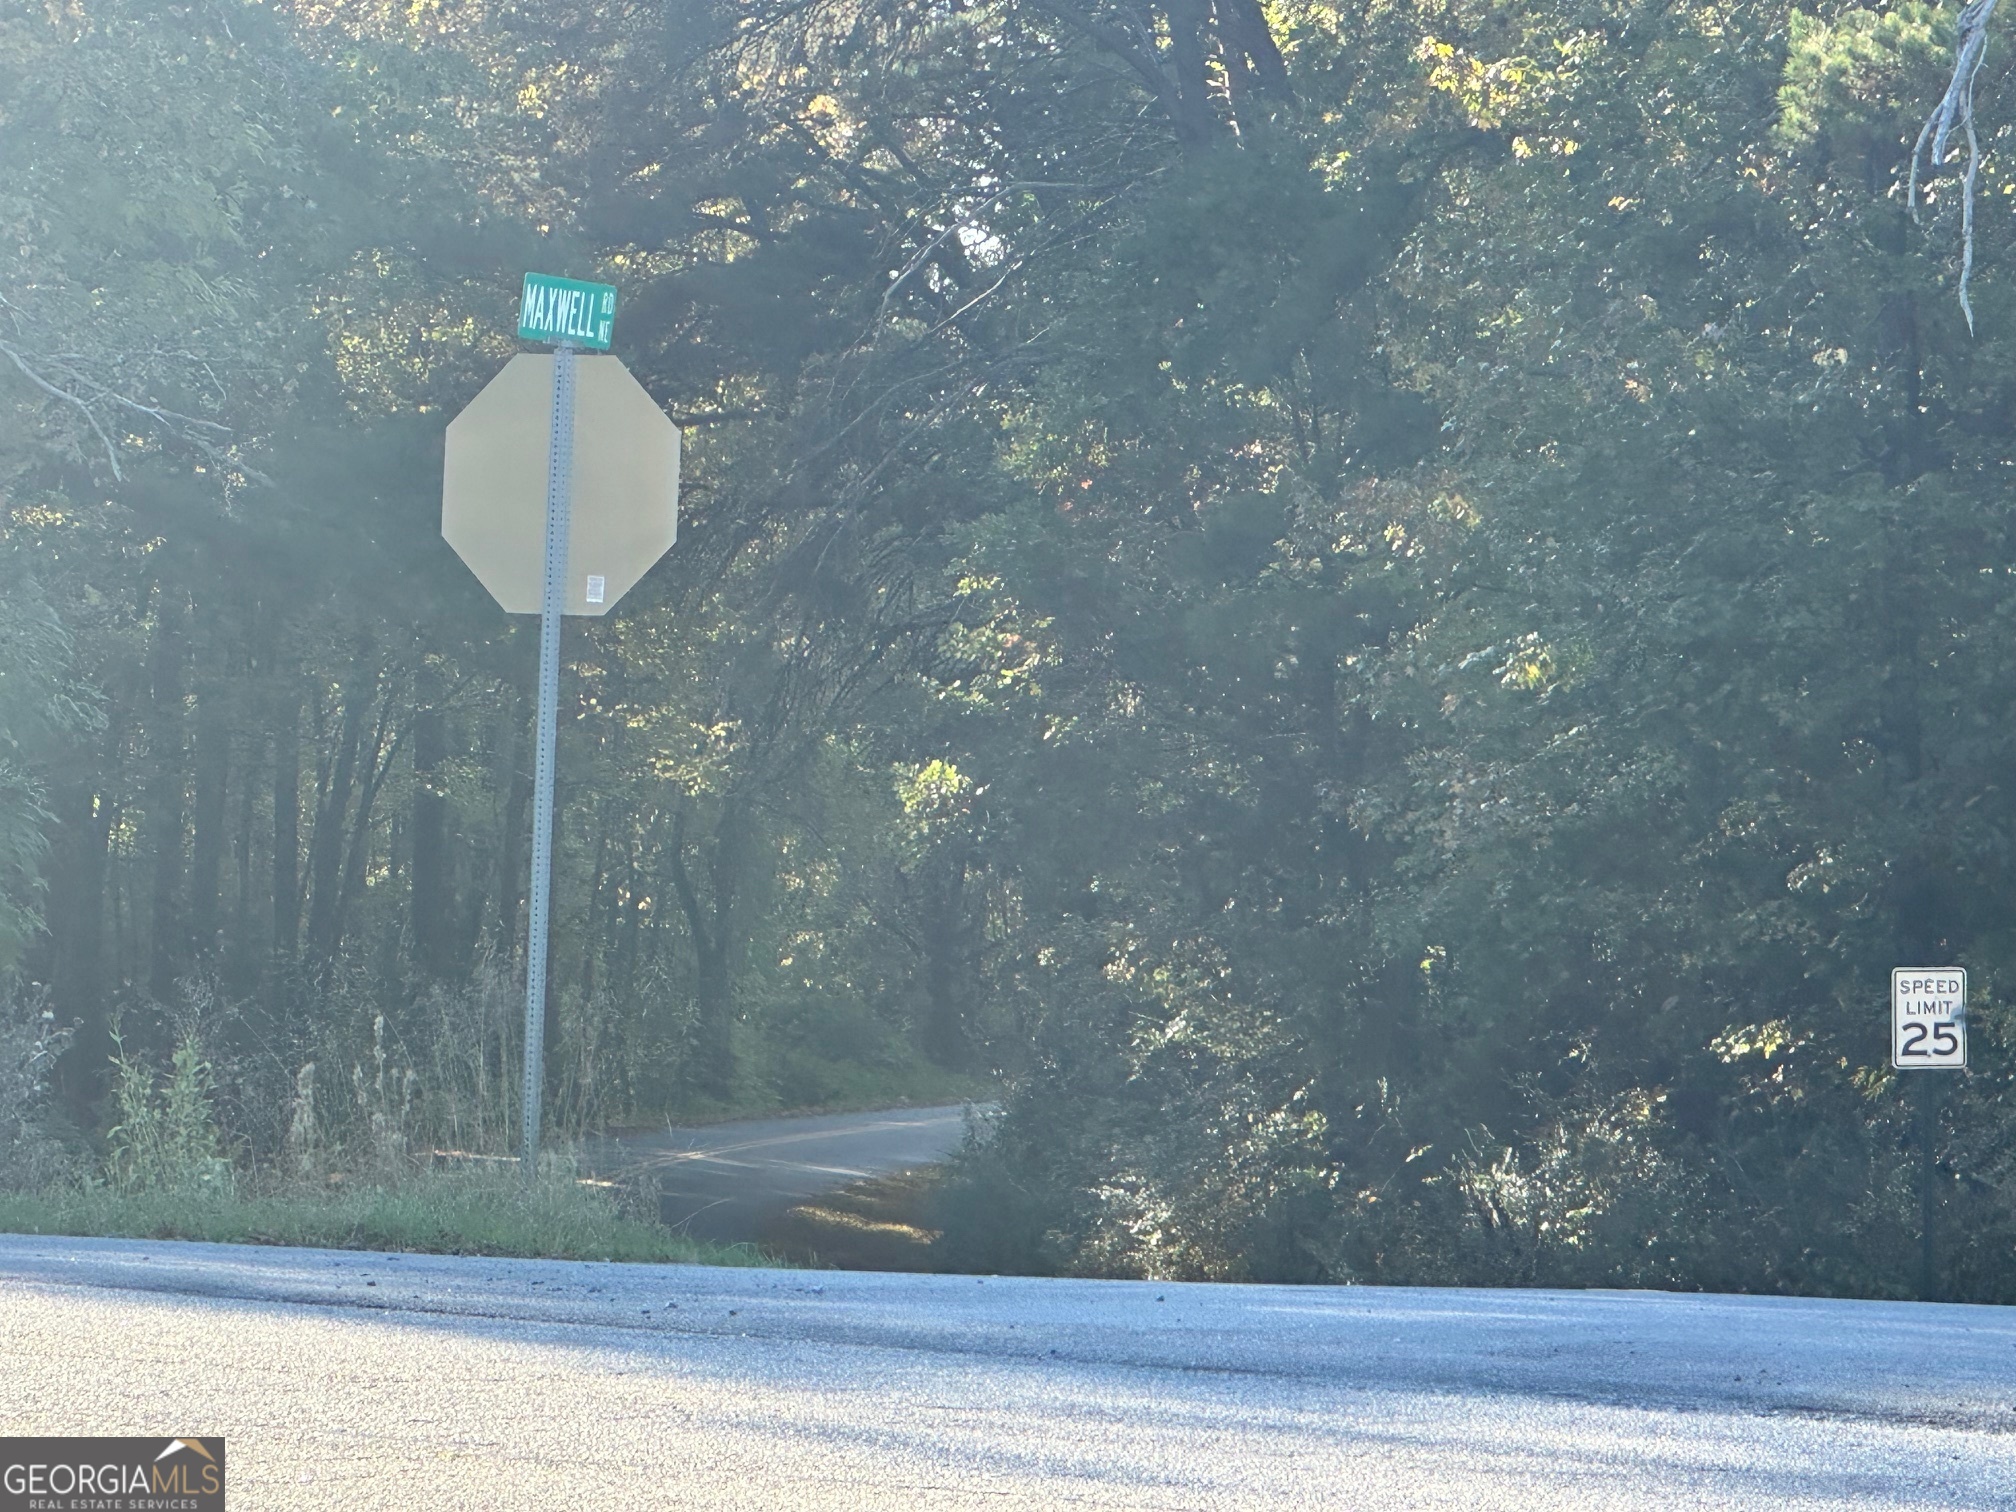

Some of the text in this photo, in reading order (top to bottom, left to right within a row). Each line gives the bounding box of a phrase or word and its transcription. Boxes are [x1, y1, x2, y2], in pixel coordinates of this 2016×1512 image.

[522, 283, 615, 338] MAXWELL RD
[597, 320, 610, 343] NE
[1900, 979, 1959, 995] SPEED
[1906, 1000, 1953, 1015] LIMIT
[1901, 1022, 1958, 1056] 25
